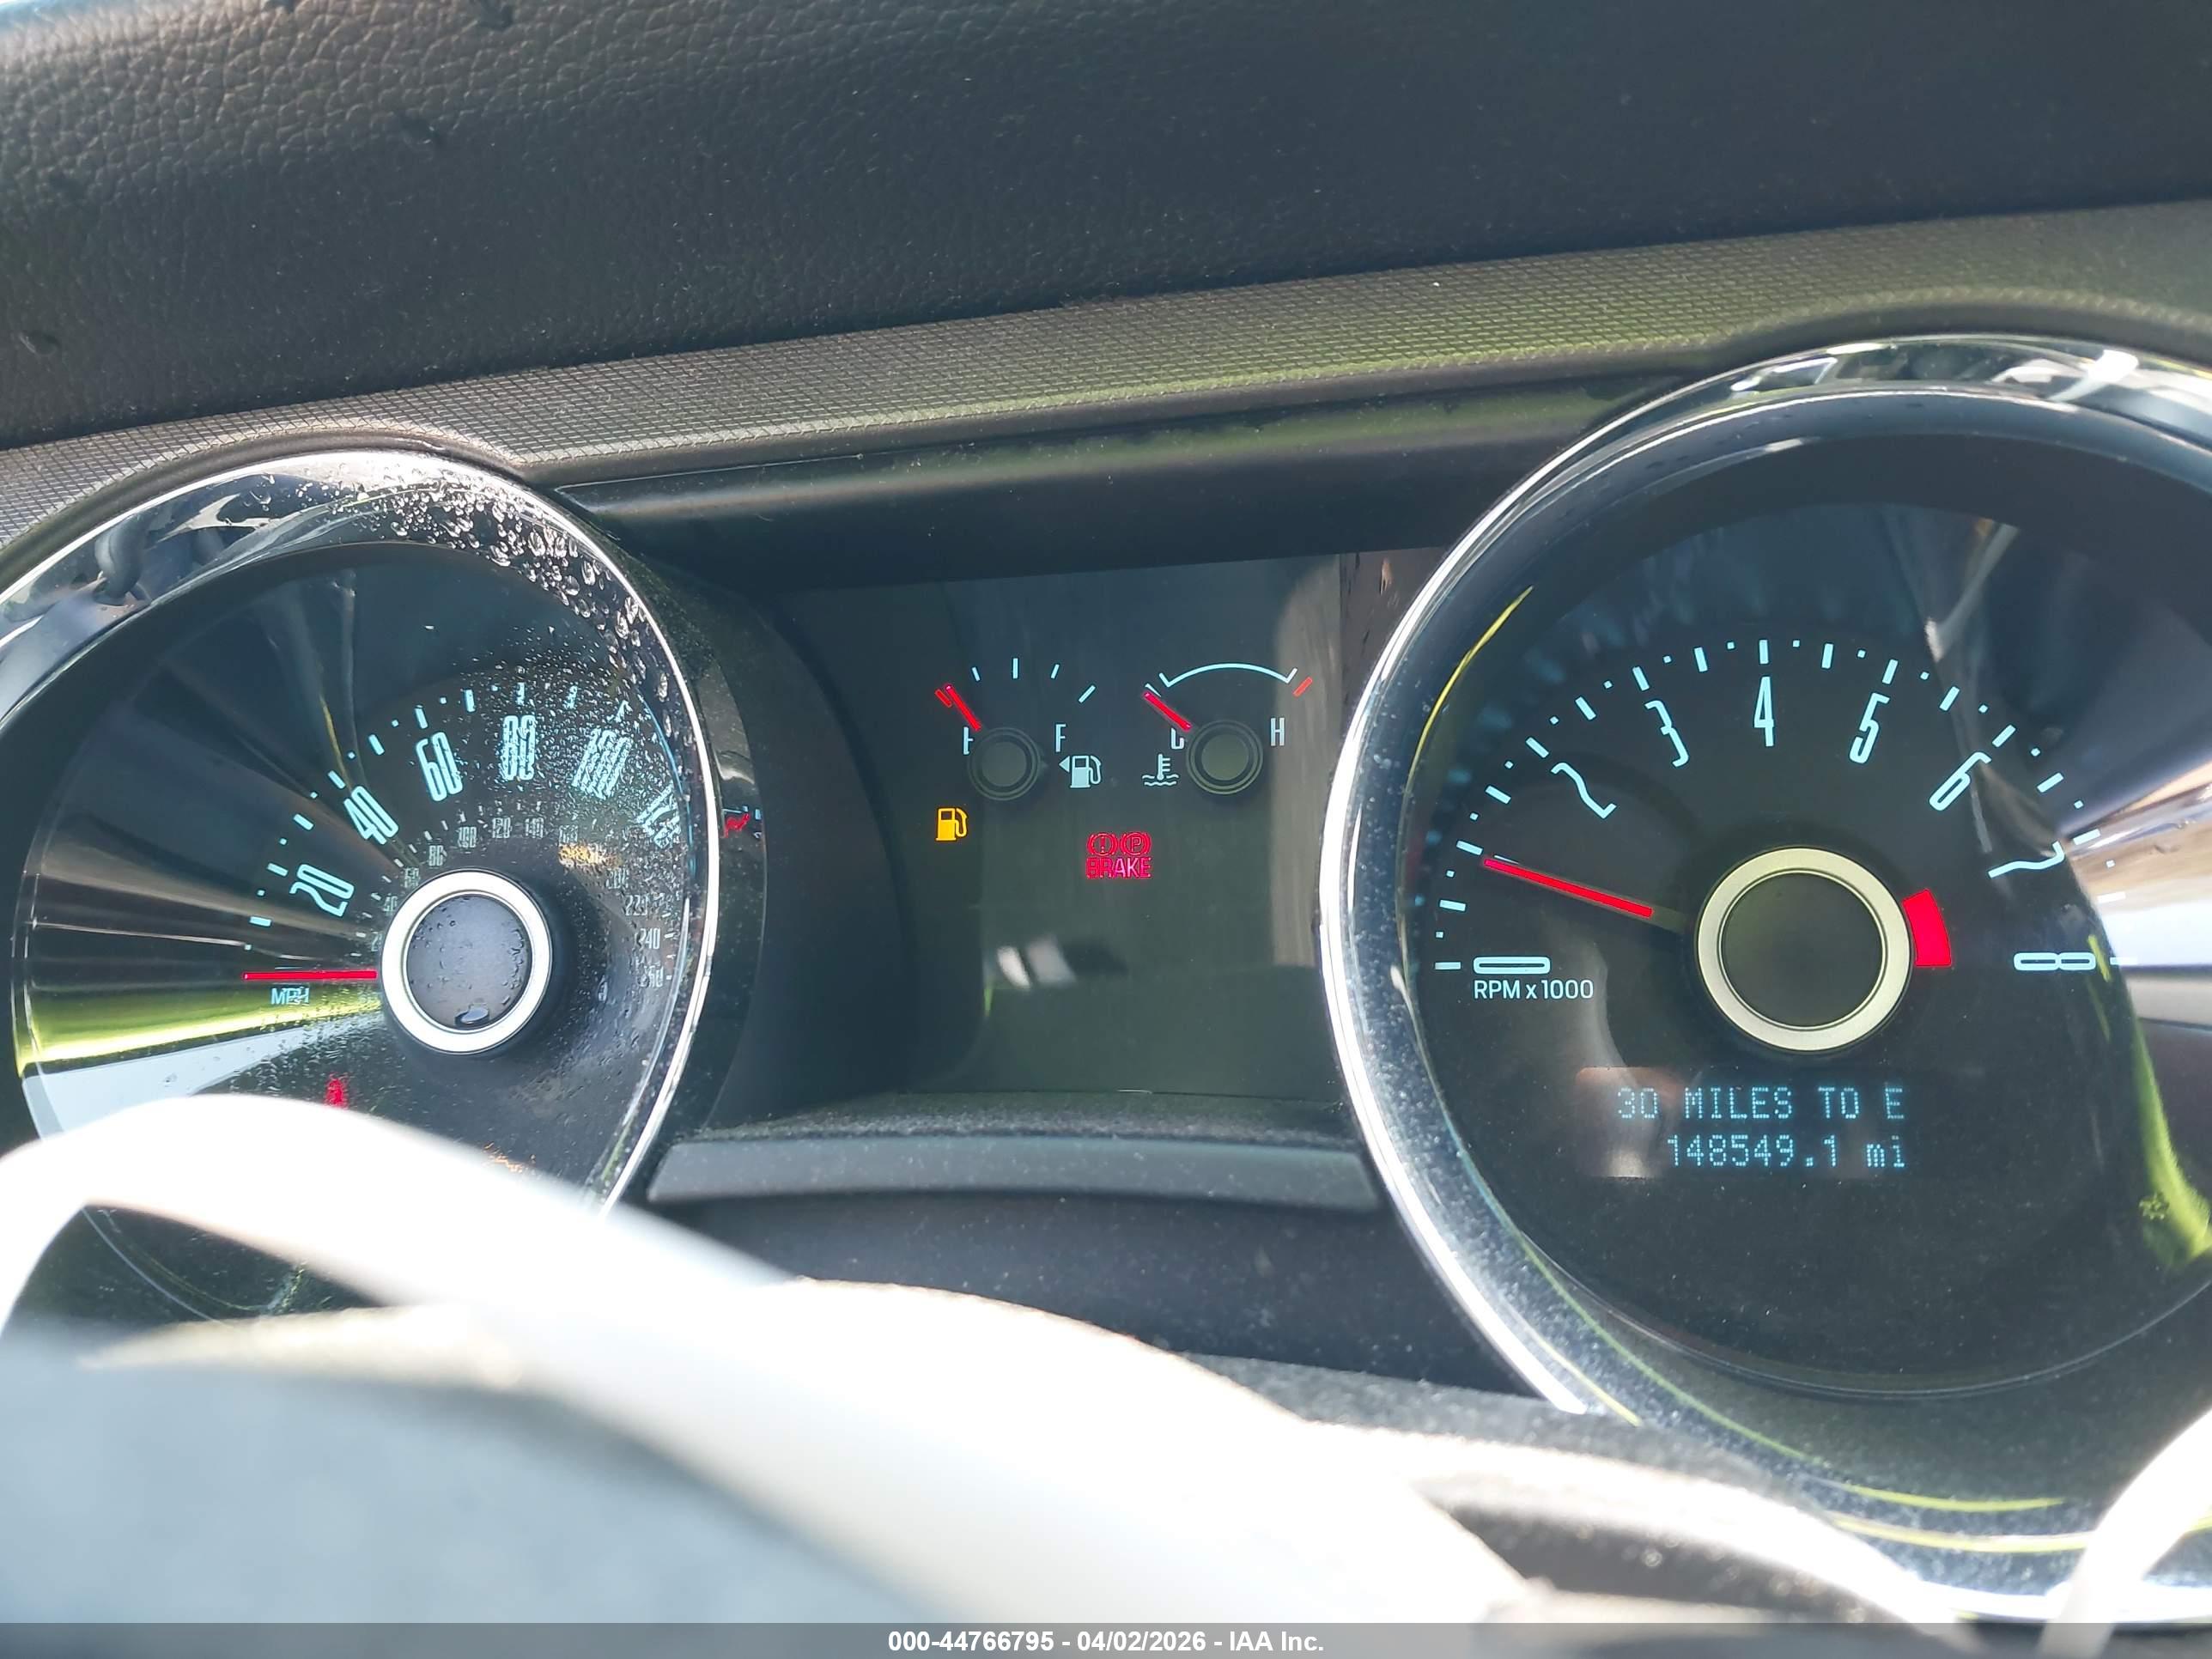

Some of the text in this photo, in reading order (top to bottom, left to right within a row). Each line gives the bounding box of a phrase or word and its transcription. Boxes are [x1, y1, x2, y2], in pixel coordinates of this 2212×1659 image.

[1753, 676, 1775, 747] 4
[1849, 692, 1890, 764] 5
[501, 714, 537, 781] 80
[1055, 724, 1066, 752] F
[1271, 718, 1285, 746] H
[1644, 700, 1690, 767] 3
[415, 732, 464, 801] 60
[1929, 751, 1992, 811] 6
[1550, 763, 1617, 818] 2
[343, 785, 399, 845] 40
[1086, 857, 1152, 878] BRAKE
[1989, 840, 2066, 878] 7
[289, 864, 355, 917] 20
[639, 927, 660, 950] 240
[2013, 951, 2096, 971] 8
[271, 987, 310, 1005] MPH
[1474, 979, 1595, 1000] RPM x 1000
[1618, 1086, 1905, 1120] 30 MILES TO E
[1667, 1133, 1905, 1169] 148549.1 mi
